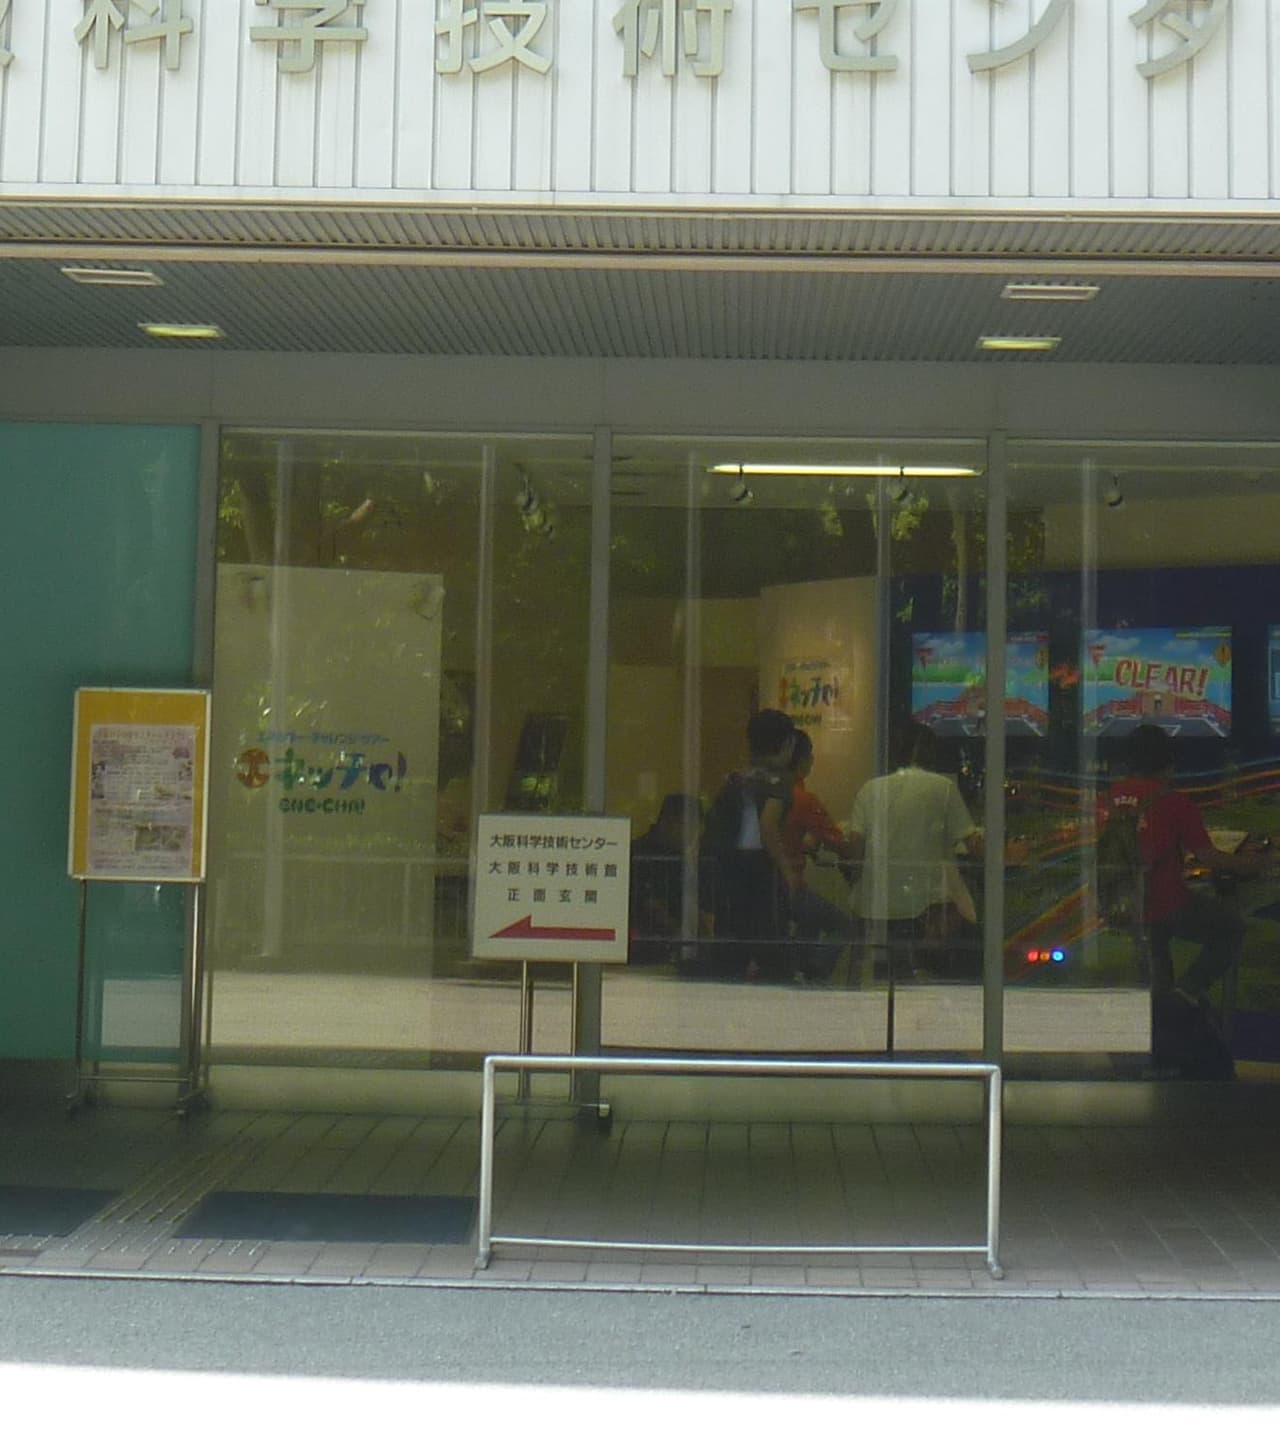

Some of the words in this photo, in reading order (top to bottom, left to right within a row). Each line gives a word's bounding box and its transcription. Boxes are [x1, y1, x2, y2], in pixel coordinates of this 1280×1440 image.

[1114, 657, 1209, 697] CLEAR!
[489, 834, 618, 850] 大阪科学技術センター
[488, 861, 618, 878] 大阪科学技術館
[507, 887, 598, 904] 正面玄関
